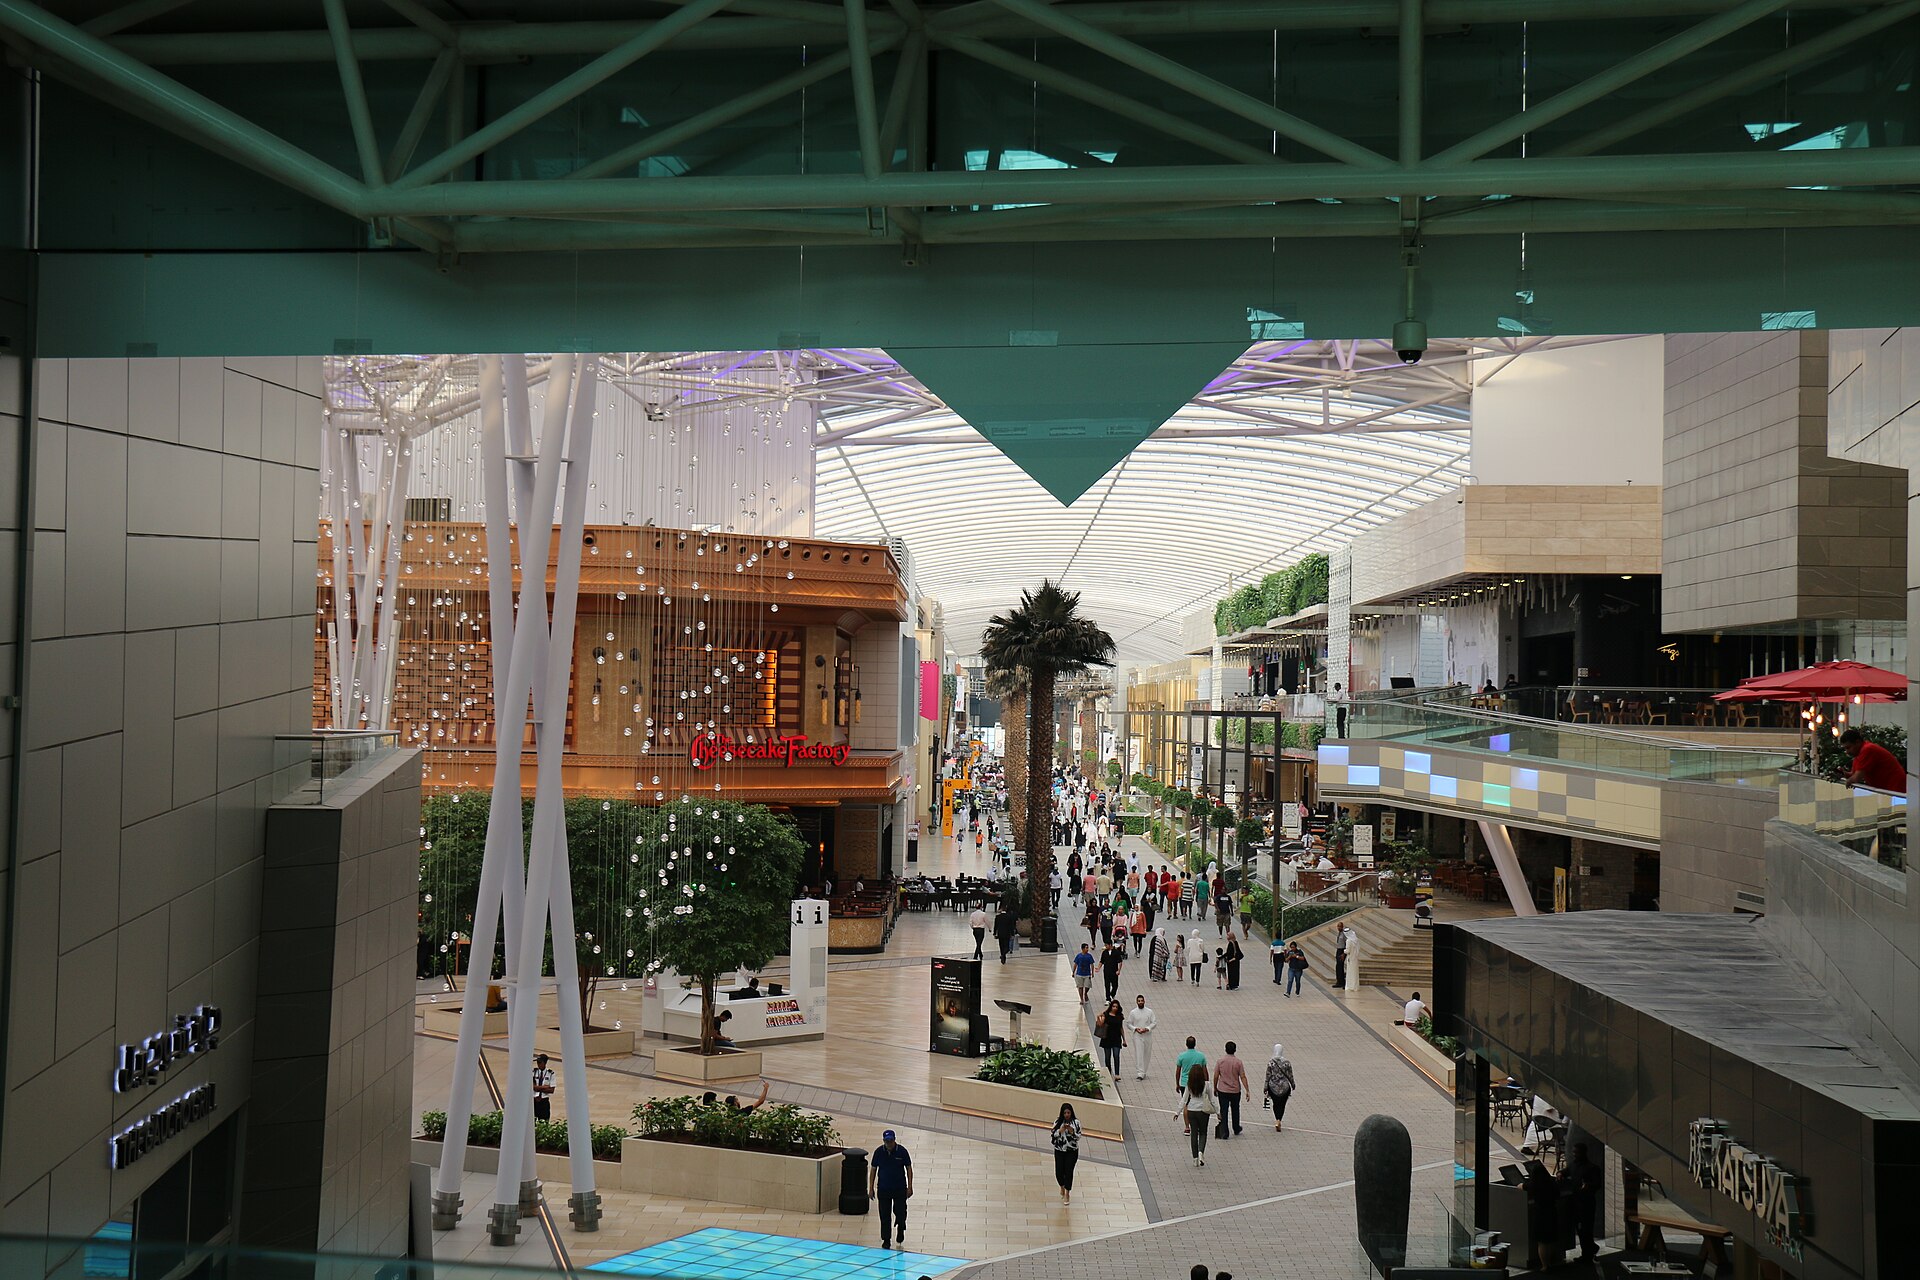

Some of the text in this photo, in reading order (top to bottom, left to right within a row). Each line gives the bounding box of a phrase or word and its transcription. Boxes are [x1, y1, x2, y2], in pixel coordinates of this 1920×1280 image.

[691, 733, 851, 770] The Cheesecake Factory
